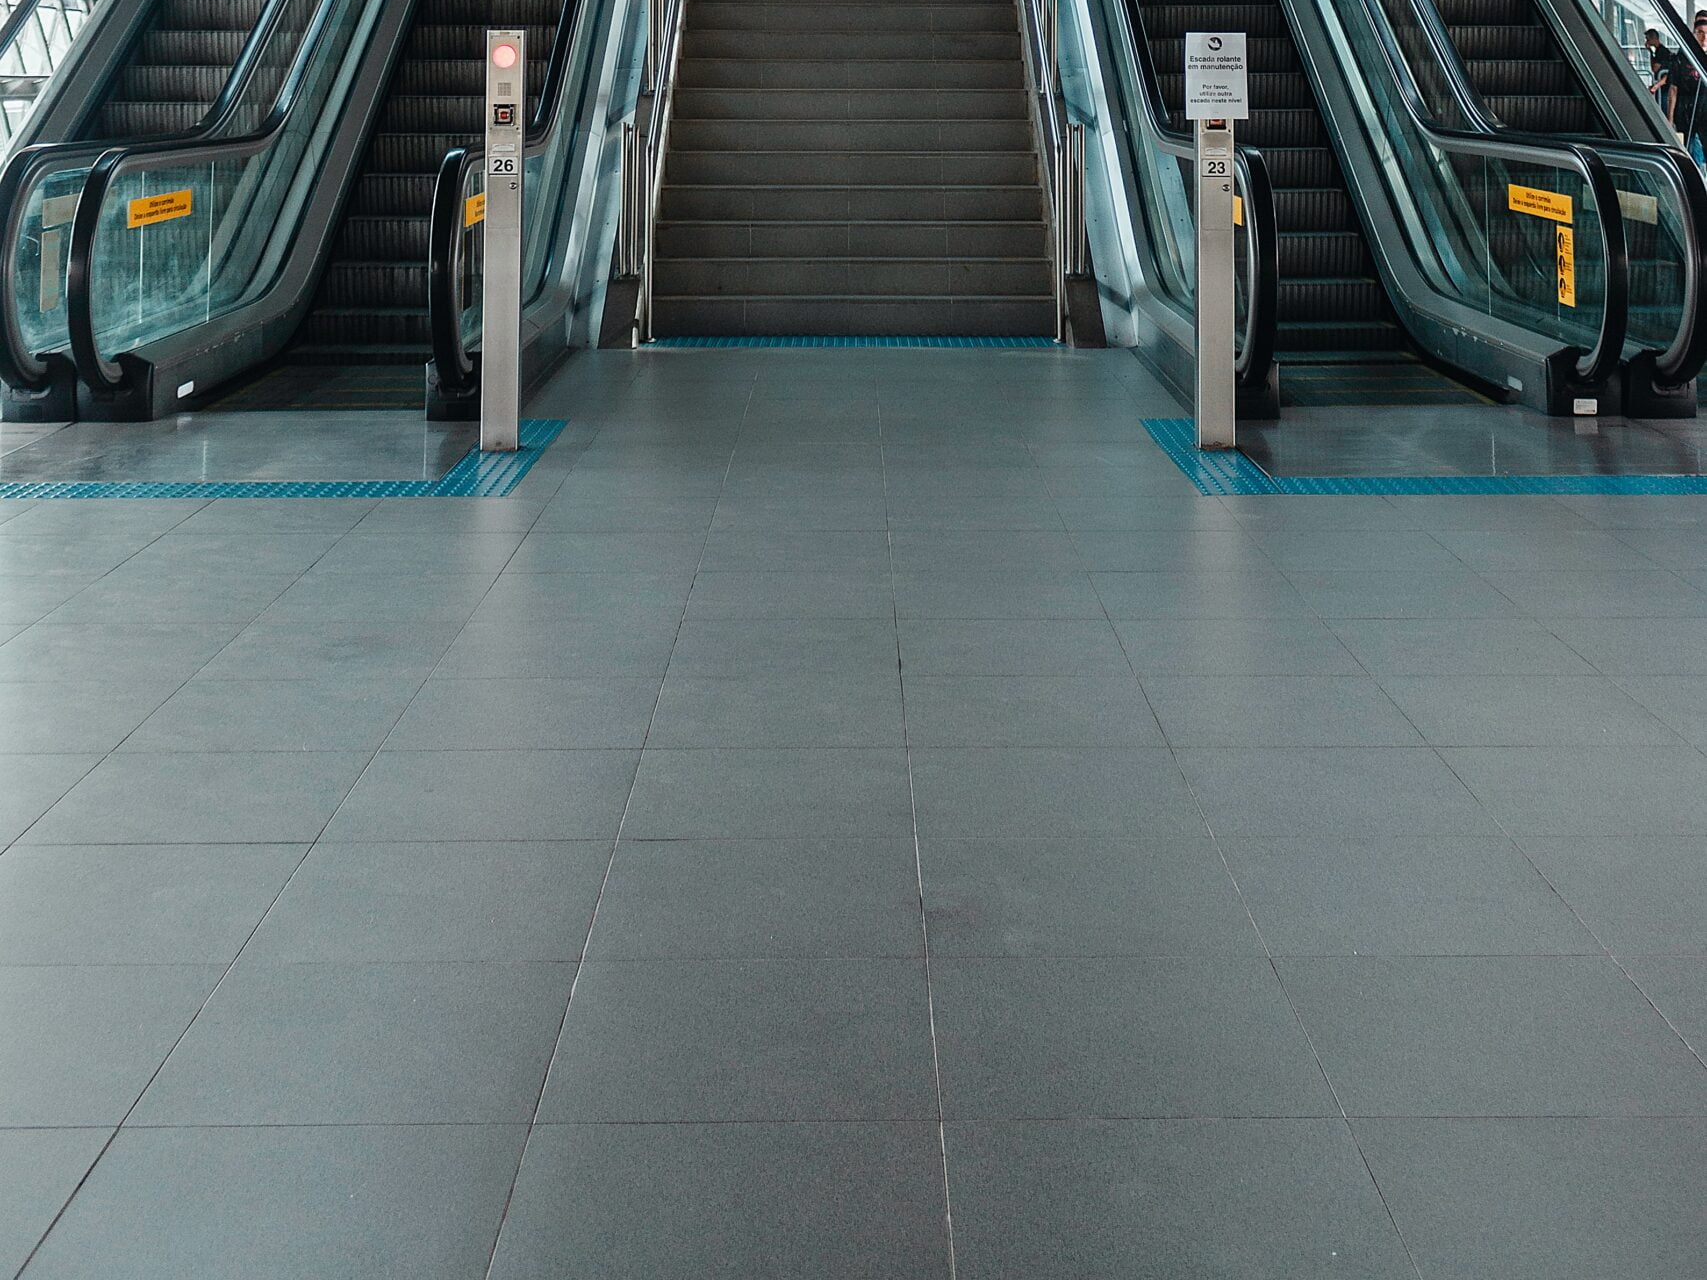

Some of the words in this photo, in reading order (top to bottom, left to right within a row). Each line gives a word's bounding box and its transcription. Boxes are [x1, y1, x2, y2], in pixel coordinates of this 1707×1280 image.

[1189, 55, 1215, 63] Escada
[1216, 55, 1241, 63] rolante
[1200, 63, 1244, 71] manutenção
[493, 159, 514, 172] 26
[1207, 161, 1226, 174] 23
